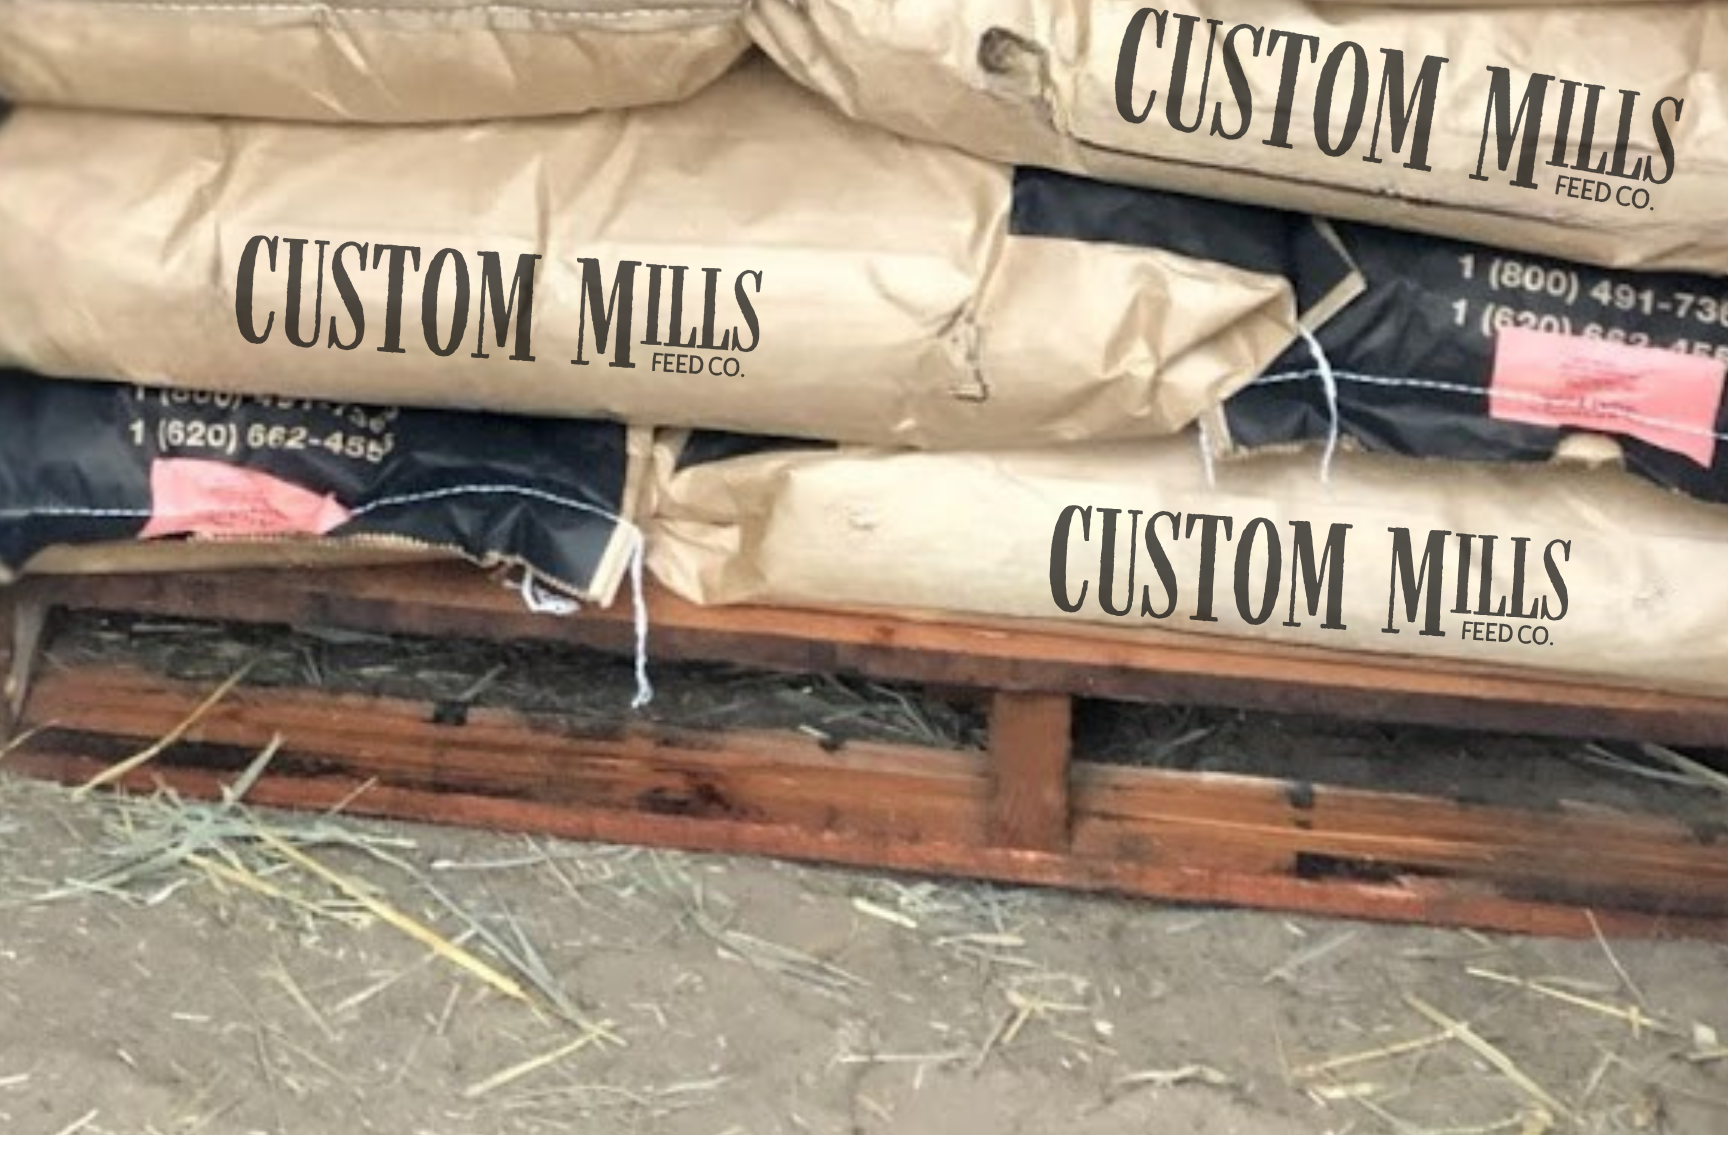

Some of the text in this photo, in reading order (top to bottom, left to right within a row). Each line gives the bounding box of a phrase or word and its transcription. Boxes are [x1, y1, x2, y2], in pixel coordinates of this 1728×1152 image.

[1115, 8, 1684, 189] CUSTOM MILLS
[1555, 174, 1655, 211] FEED CO.
[1458, 254, 1475, 279] 1
[1488, 258, 1579, 305] (800)
[236, 236, 763, 368] CUSTOM MILLS
[1451, 299, 1468, 325] 1
[651, 353, 746, 378] FEED CO.
[129, 419, 145, 446] 1
[158, 418, 237, 455] (620)
[1050, 506, 1572, 636] CUSTOM MILLS
[1461, 621, 1555, 646] FEED CO.
